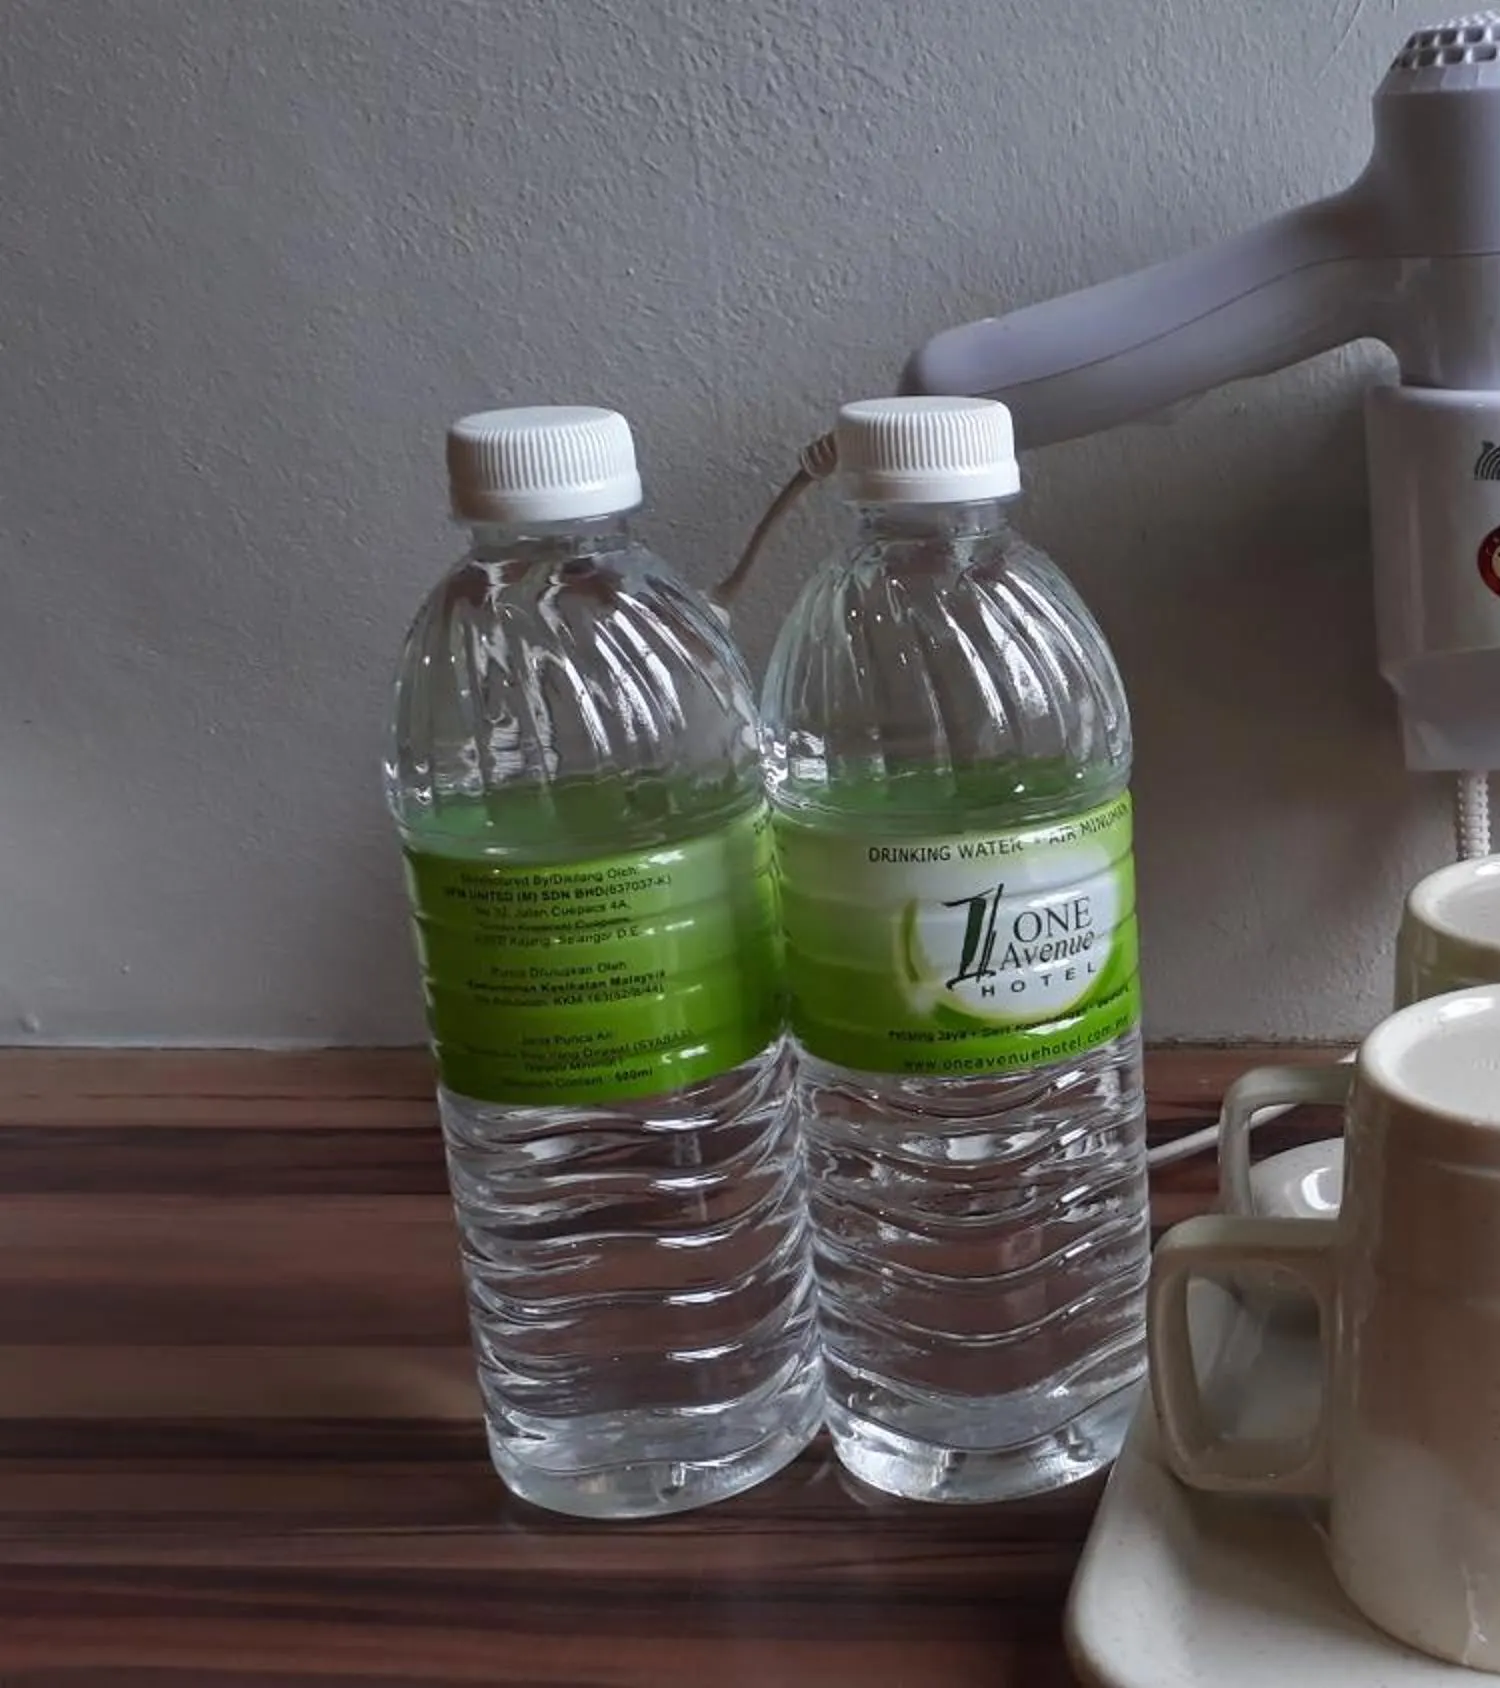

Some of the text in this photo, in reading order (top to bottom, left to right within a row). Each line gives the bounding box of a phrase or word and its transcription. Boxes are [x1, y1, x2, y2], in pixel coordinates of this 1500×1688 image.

[868, 845, 952, 864] DRINKING
[957, 839, 1024, 860] WATER
[1013, 895, 1093, 943] ONE
[1000, 930, 1095, 971] Avenue
[981, 960, 1096, 998] HOTEL
